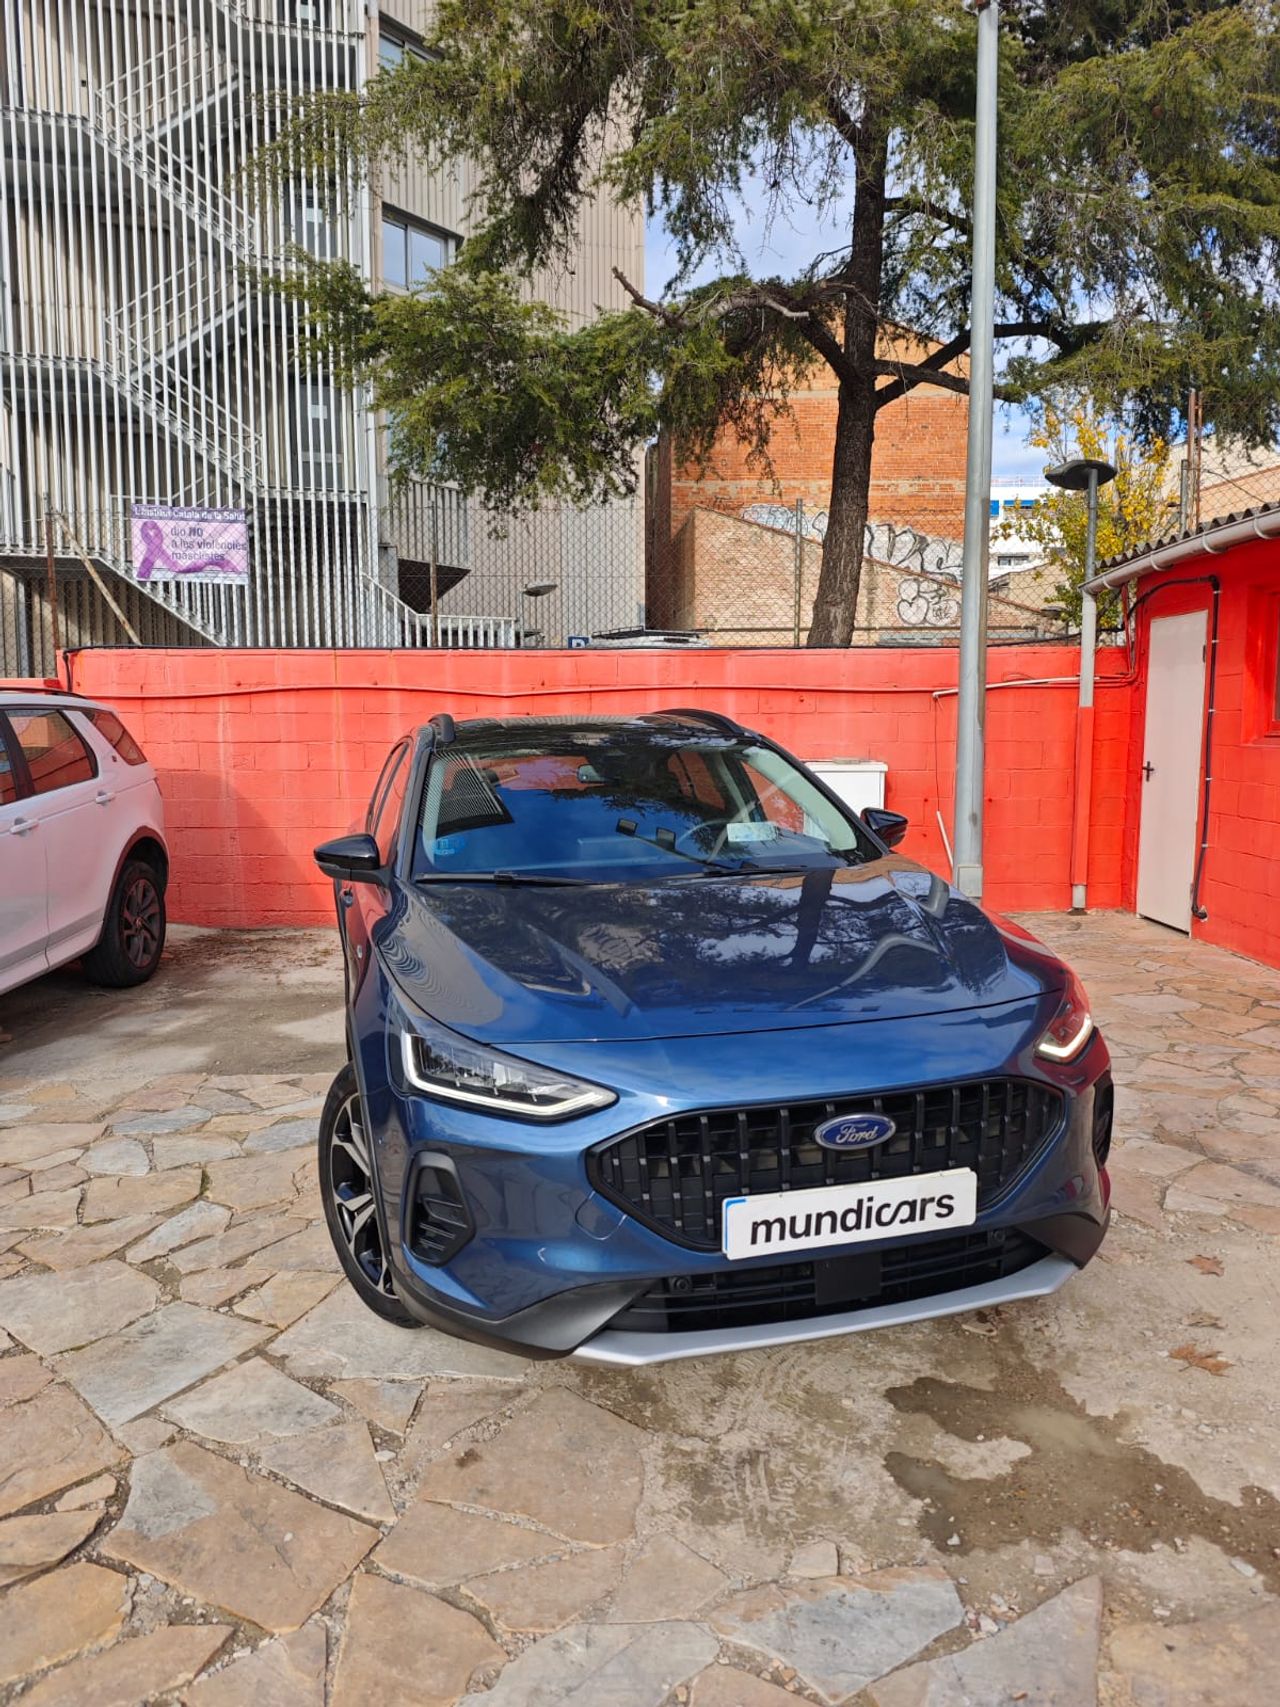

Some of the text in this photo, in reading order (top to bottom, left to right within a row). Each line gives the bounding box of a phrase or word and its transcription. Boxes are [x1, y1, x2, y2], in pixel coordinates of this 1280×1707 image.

[214, 511, 222, 520] la
[188, 527, 204, 538] NO
[171, 539, 177, 549] a
[836, 1122, 878, 1144] Ford
[750, 1193, 955, 1246] mundicars
